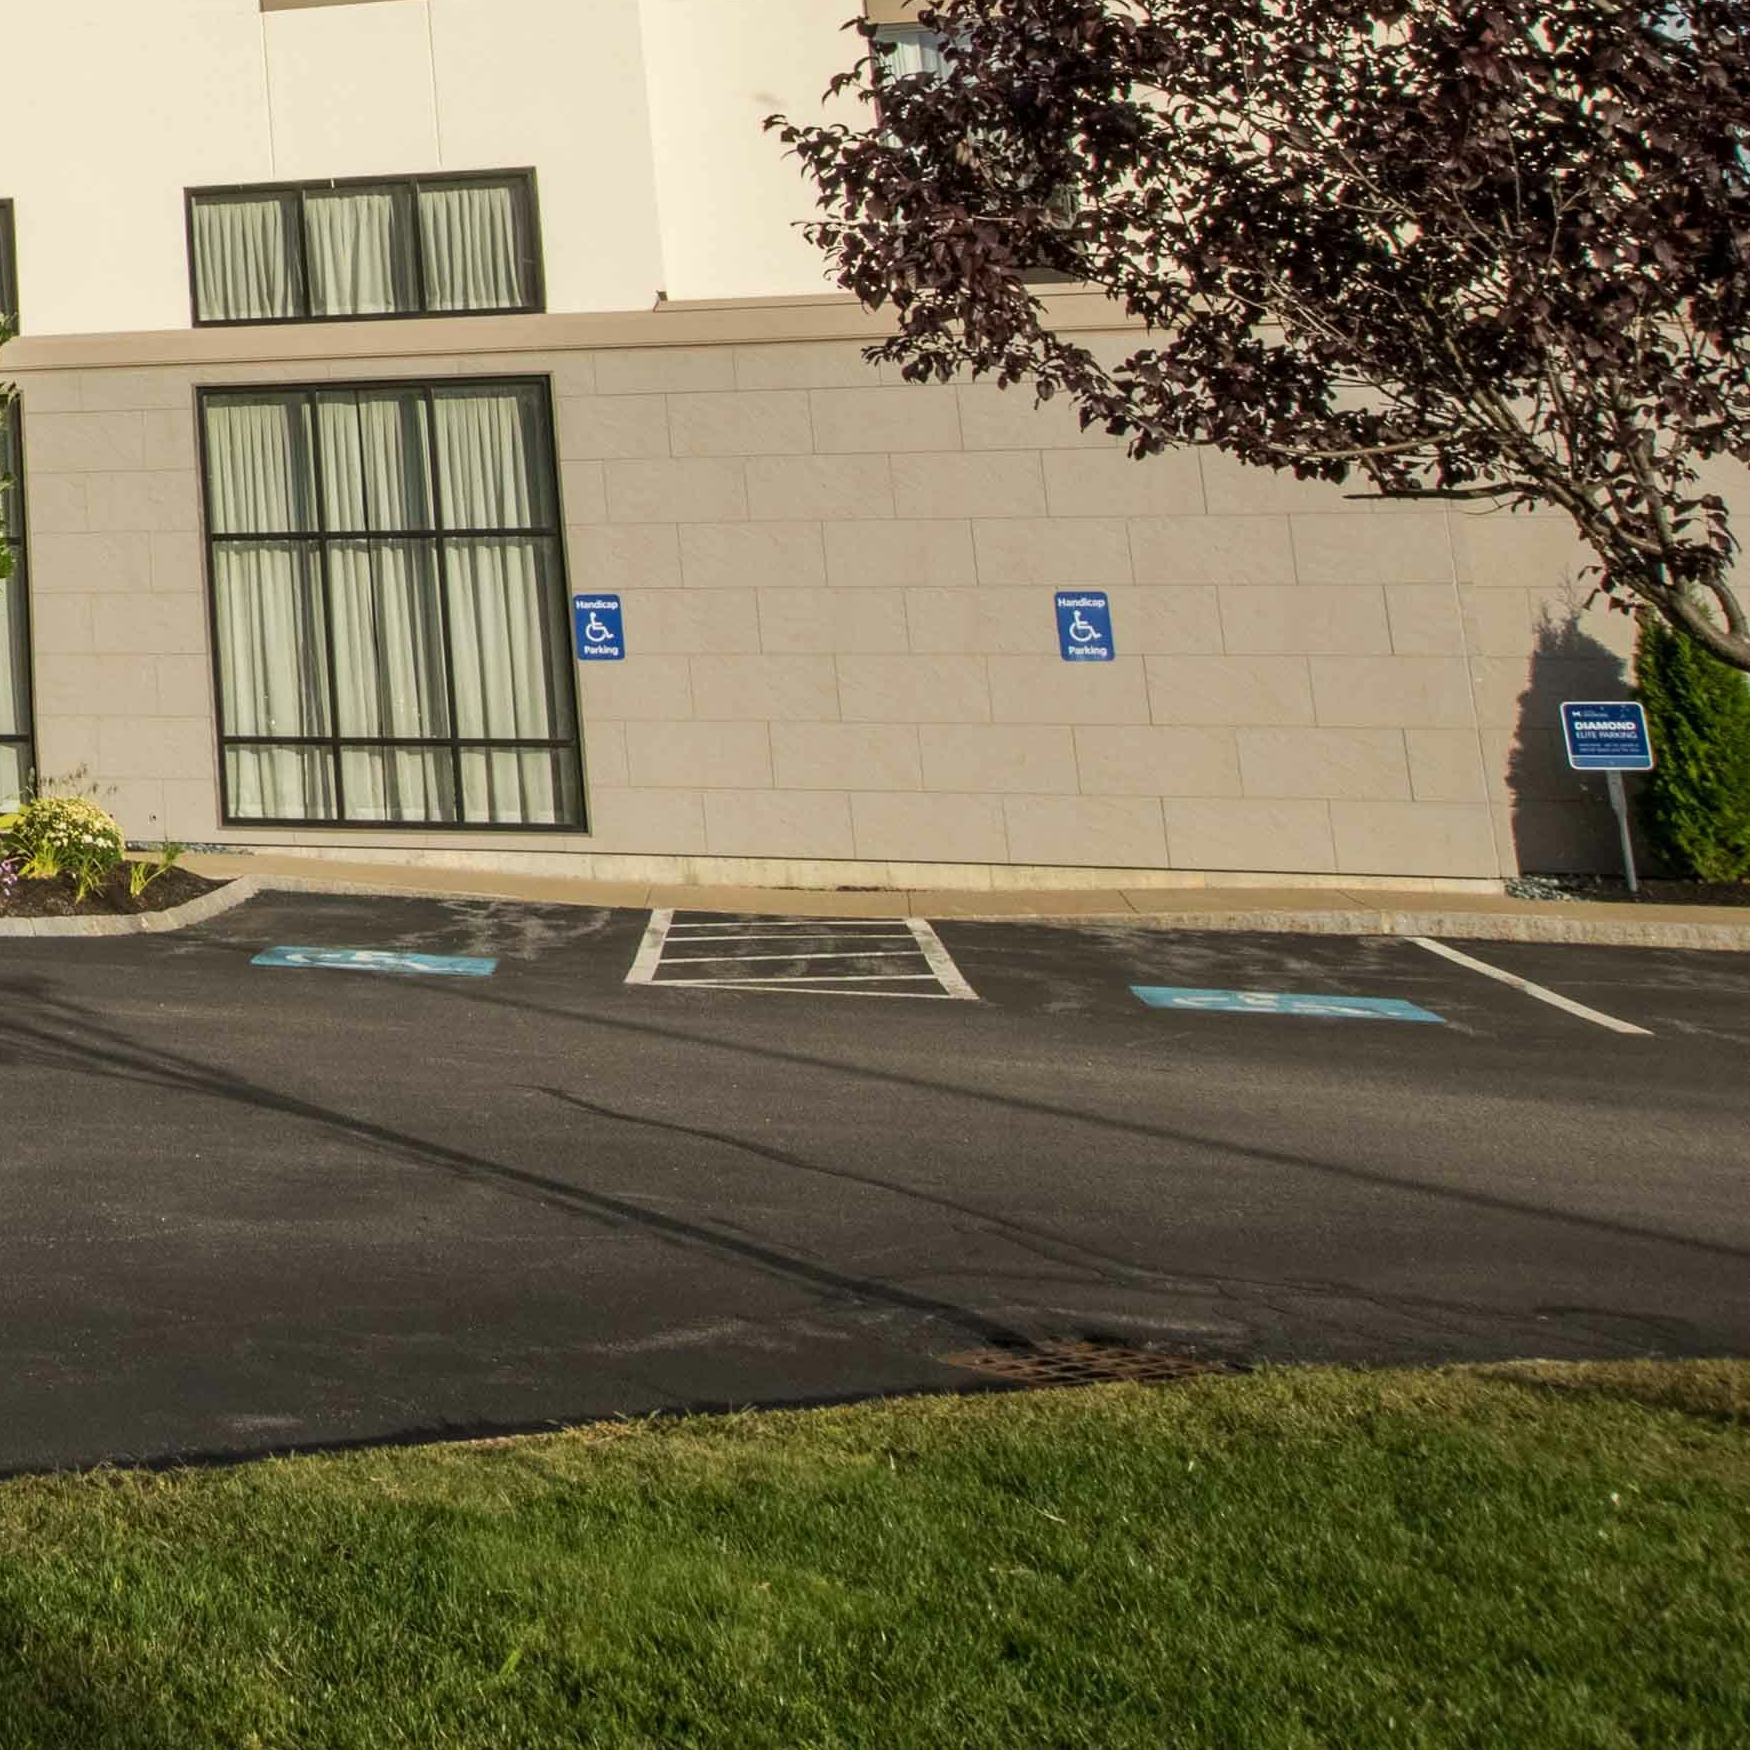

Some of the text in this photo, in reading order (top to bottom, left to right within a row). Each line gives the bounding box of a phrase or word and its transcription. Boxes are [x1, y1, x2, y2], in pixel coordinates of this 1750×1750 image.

[575, 600, 618, 610] Handicap
[1057, 597, 1105, 608] Handicap
[583, 644, 619, 656] Parking
[1068, 645, 1108, 657] Parking
[1574, 721, 1637, 731] DIAMOND
[1575, 731, 1638, 739] ELITE PARKING
